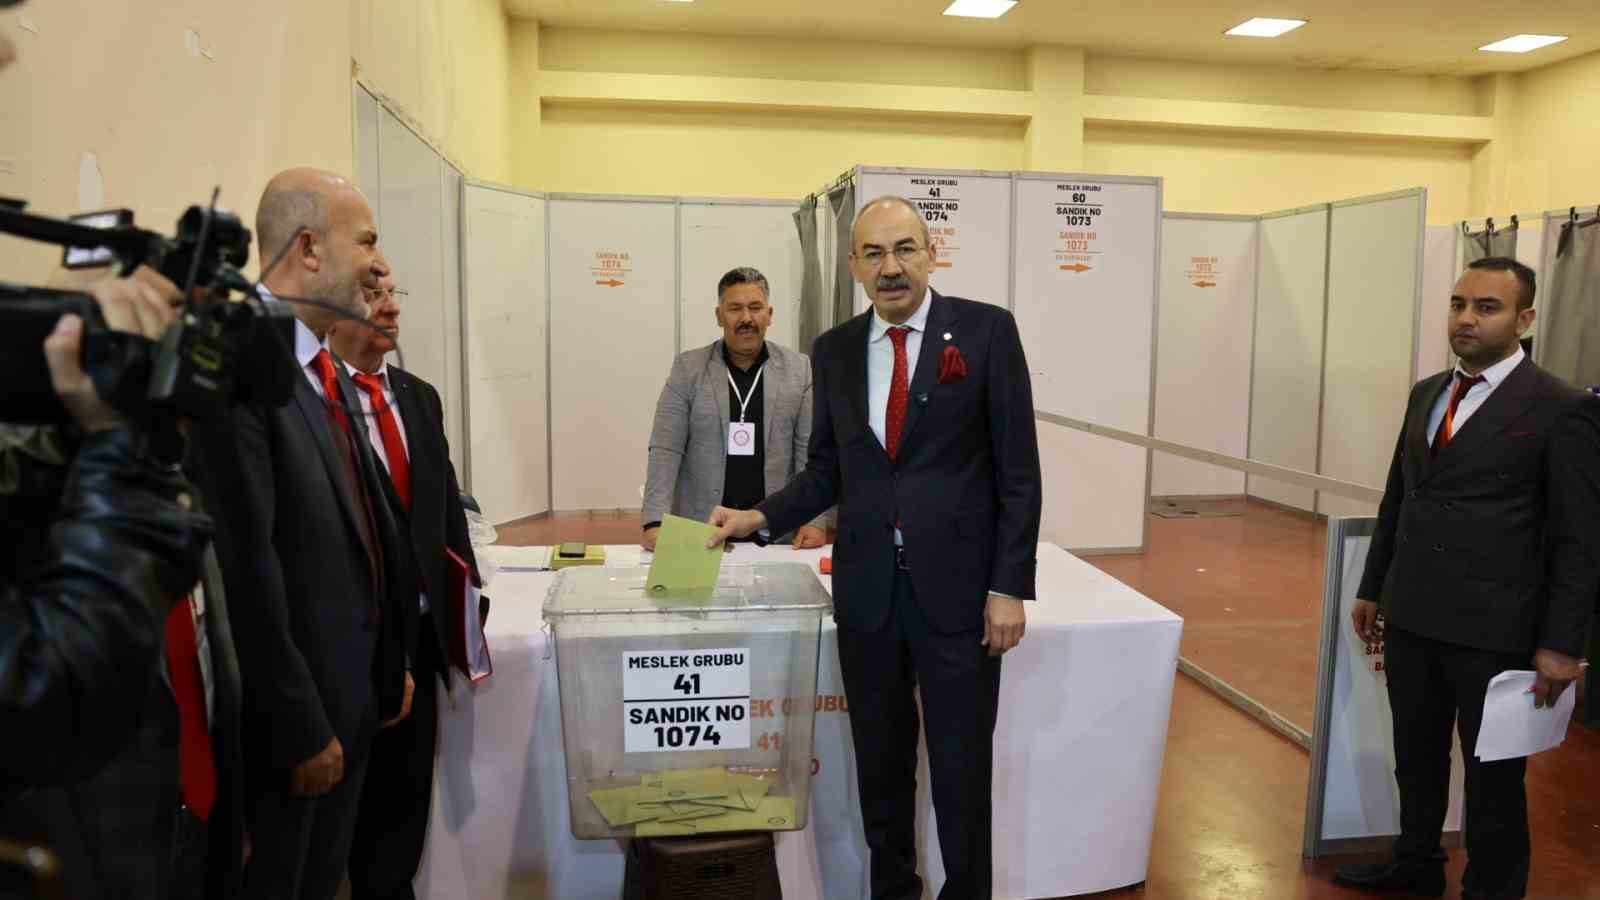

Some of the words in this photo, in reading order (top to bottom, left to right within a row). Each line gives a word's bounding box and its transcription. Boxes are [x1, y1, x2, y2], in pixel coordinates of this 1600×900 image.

[928, 187, 941, 198] 41
[1072, 192, 1086, 203] 60
[917, 202, 944, 211] ANDIK
[945, 202, 958, 212] NO
[1056, 206, 1087, 215] SANDIK
[1089, 207, 1102, 217] NO
[925, 211, 948, 222] 074
[1066, 215, 1091, 226] 1073
[1067, 240, 1088, 250] 1073
[628, 655, 689, 669] MESLEK
[693, 653, 744, 667] GRUBU
[673, 673, 701, 695] 41
[629, 706, 711, 725] SANDIK
[716, 704, 745, 722] NO
[653, 725, 721, 748] 1074
